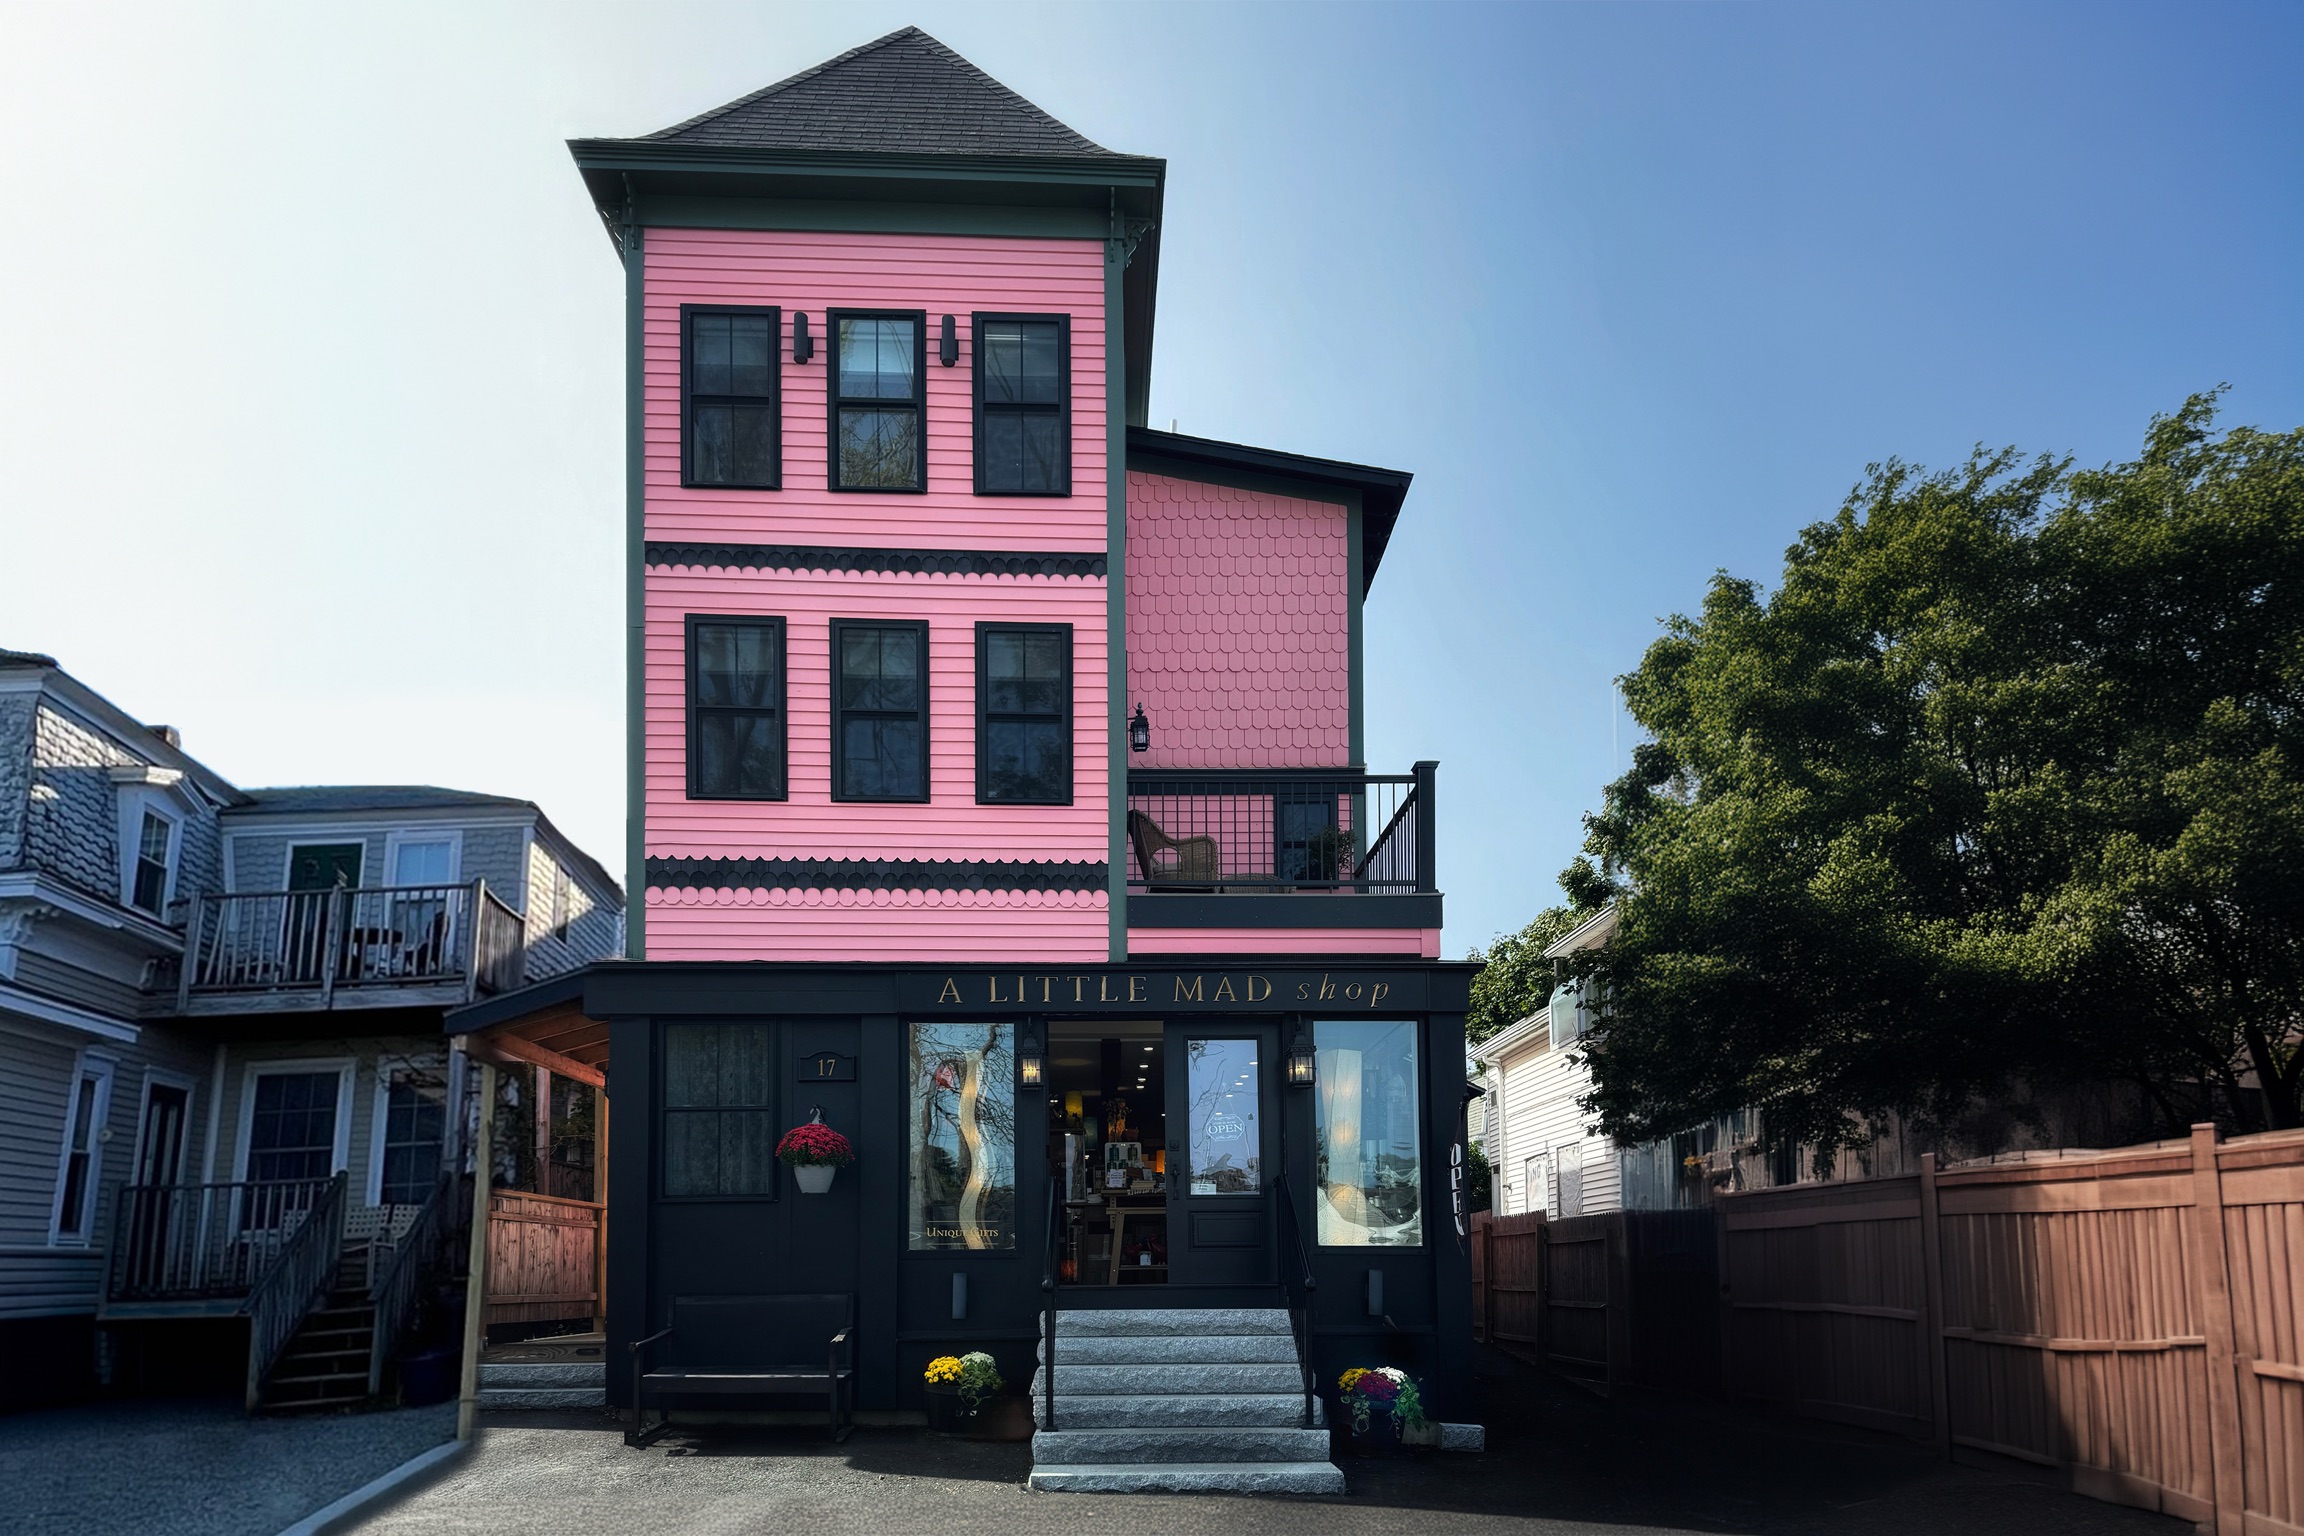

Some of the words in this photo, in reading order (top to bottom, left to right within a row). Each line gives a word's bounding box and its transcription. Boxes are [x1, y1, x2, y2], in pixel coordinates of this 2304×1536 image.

[937, 977, 963, 1004] A
[988, 975, 1148, 1003] LITTLE
[1173, 975, 1272, 1003] MAD
[1296, 973, 1390, 1008] shop
[818, 1058, 836, 1077] 17
[1208, 1124, 1243, 1134] OPEN
